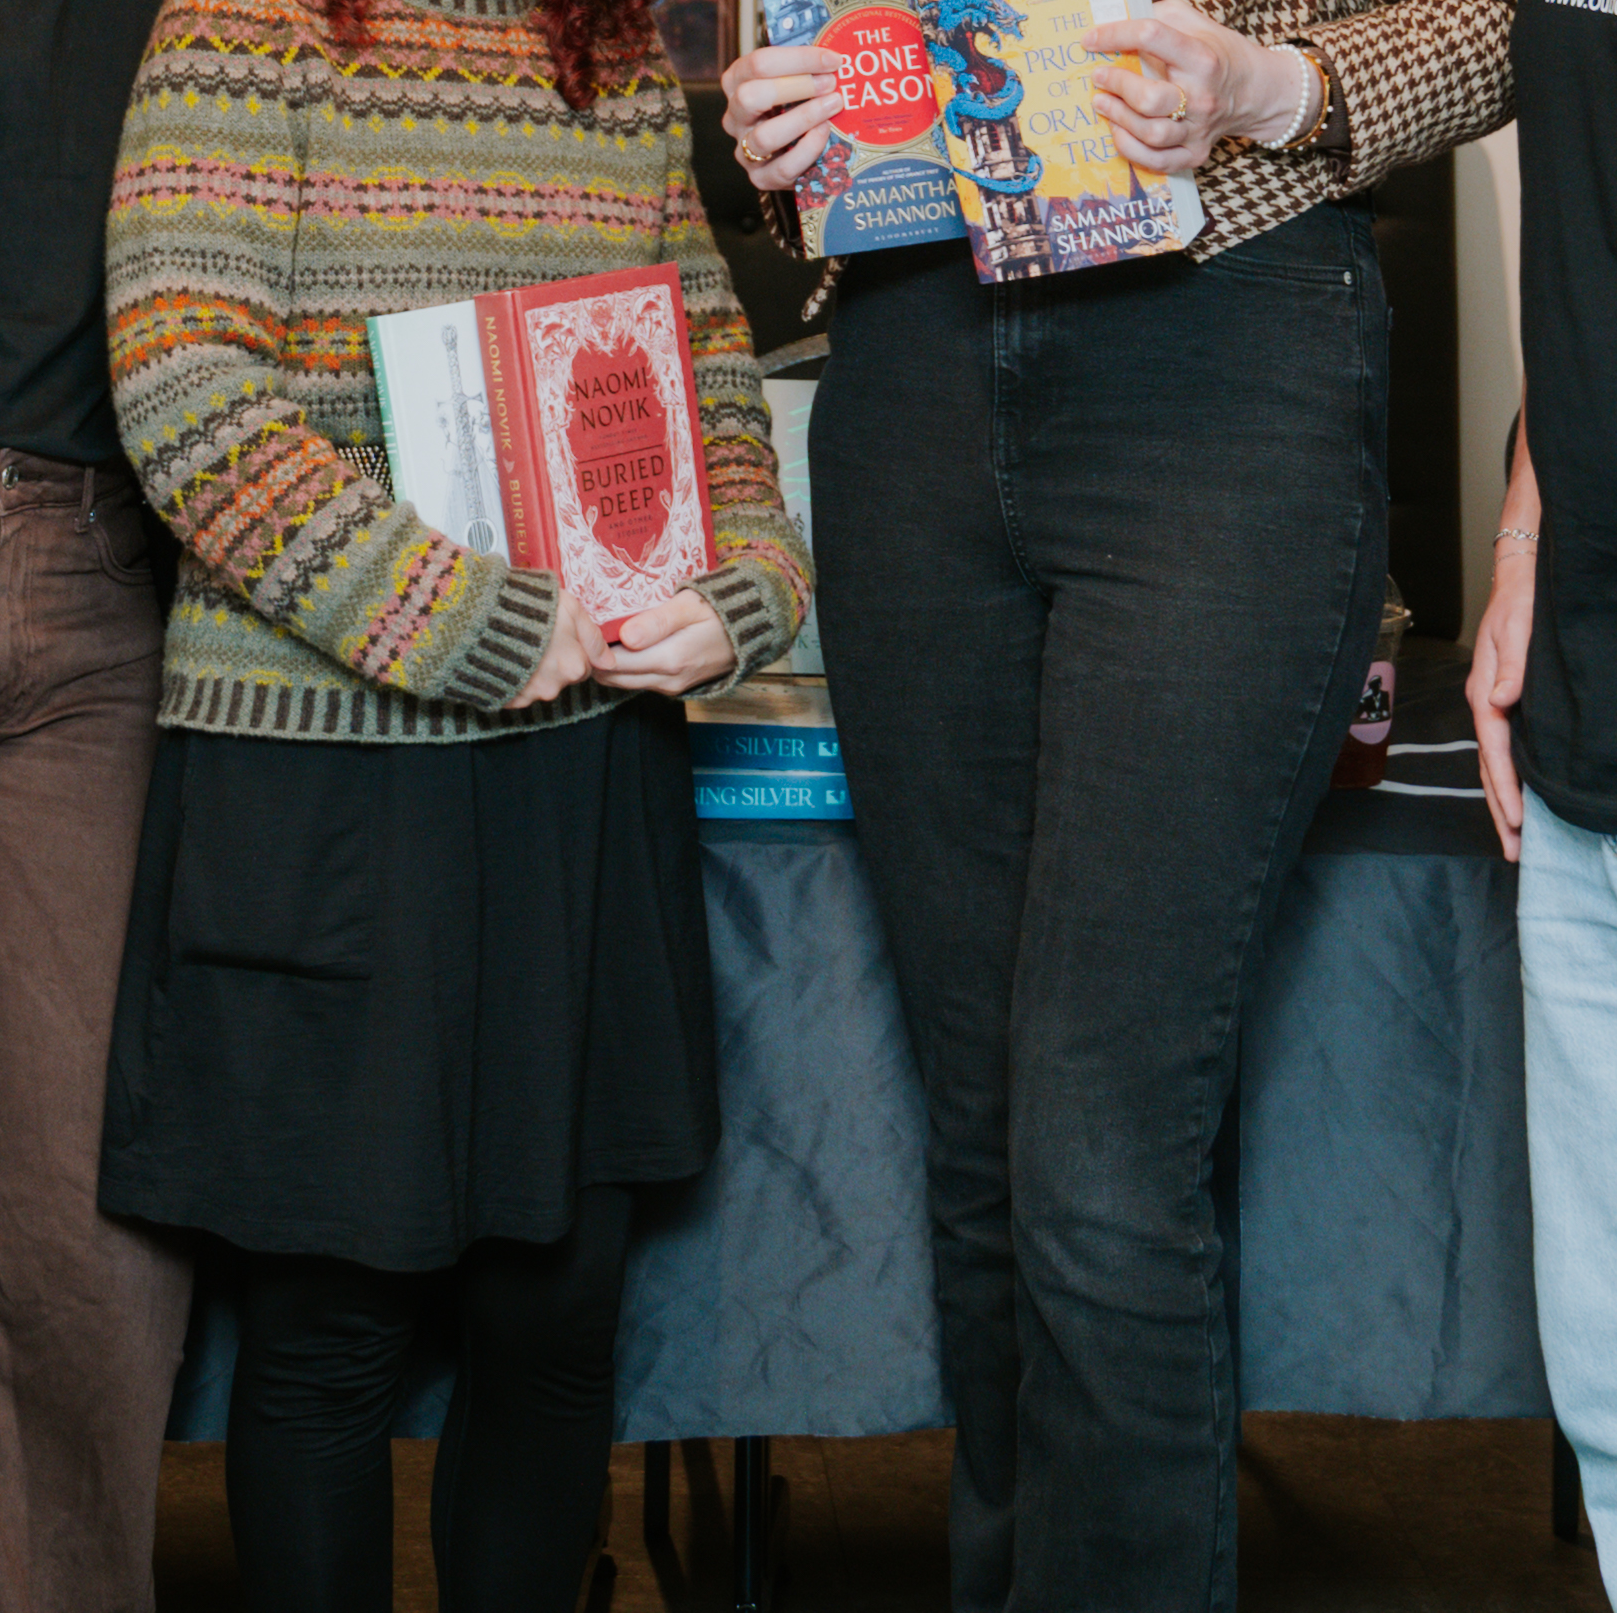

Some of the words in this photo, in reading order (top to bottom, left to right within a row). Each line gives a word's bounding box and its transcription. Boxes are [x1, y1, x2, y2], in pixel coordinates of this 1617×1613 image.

[853, 27, 893, 46] THE
[1048, 11, 1089, 32] THE
[838, 43, 922, 80] BONE
[1024, 41, 1122, 74] PRIO
[839, 74, 934, 111] EASON
[1048, 79, 1071, 98] OF
[1060, 134, 1119, 165] TRE
[843, 178, 958, 211] SAMANTHA
[854, 200, 957, 231] SHANNON
[1051, 197, 1170, 233] SAMANTHA
[1057, 215, 1177, 255] SHANNON
[574, 366, 648, 402] NAOMI
[580, 397, 651, 431] NOVIK
[485, 316, 503, 383] NAOMI
[494, 388, 513, 450] NOVIK
[508, 479, 529, 555] BURIED
[580, 454, 665, 492] BURIED
[600, 486, 654, 518] DEEP
[735, 737, 805, 758] SILVER
[741, 787, 813, 807] SILVER
